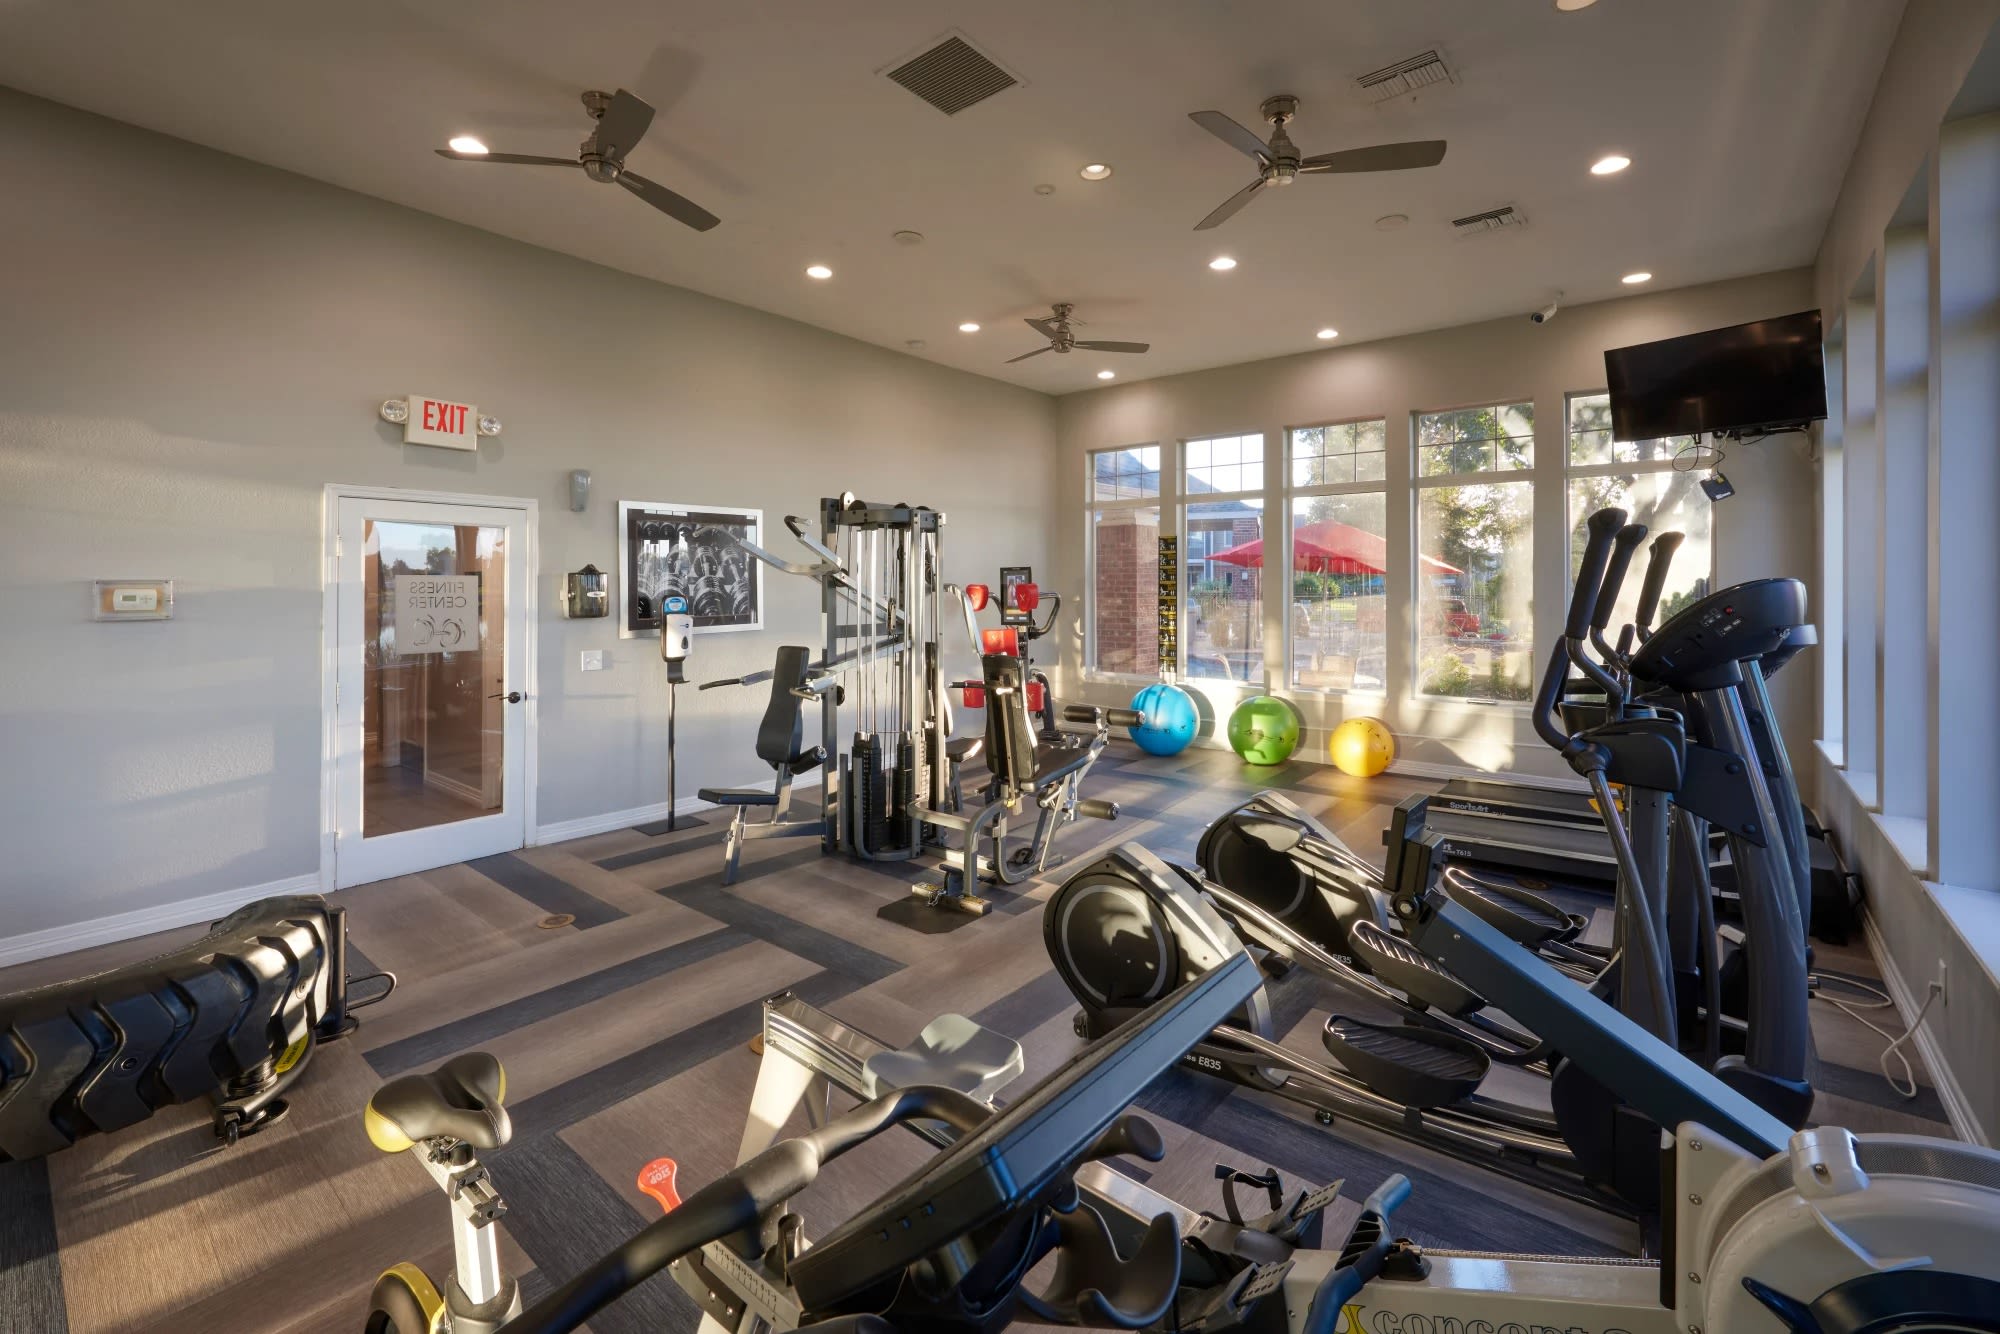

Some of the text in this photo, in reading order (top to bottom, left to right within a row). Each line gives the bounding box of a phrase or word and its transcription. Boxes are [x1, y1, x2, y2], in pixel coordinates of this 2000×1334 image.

[423, 401, 468, 434] EXIT
[1450, 802, 1489, 812] SportsArt
[1199, 1056, 1222, 1070] E835
[650, 1167, 671, 1185] STOP
